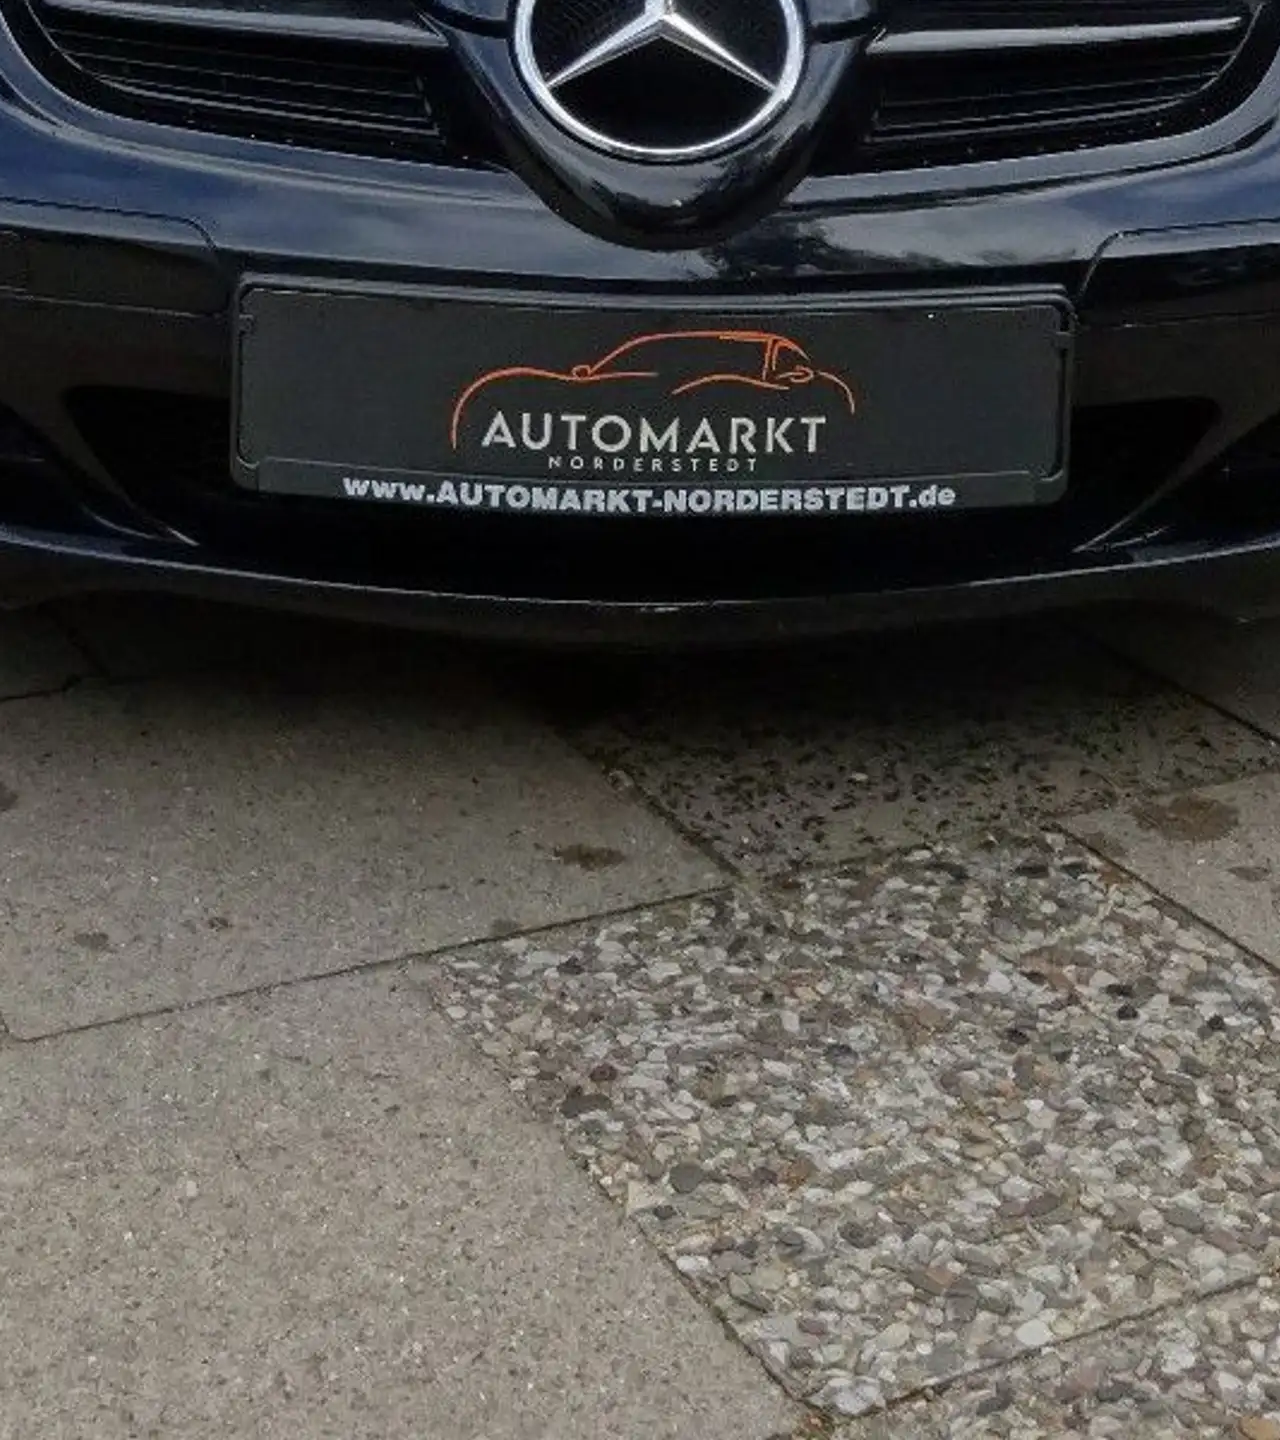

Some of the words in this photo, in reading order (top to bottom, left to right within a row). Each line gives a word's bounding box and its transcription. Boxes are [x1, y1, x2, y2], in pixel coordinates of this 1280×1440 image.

[481, 411, 826, 454] AUTOMARKT
[547, 455, 758, 473] NORDERSTEDT
[342, 476, 956, 513] www.AUTOMARKT-NORDERSTEDT.de
